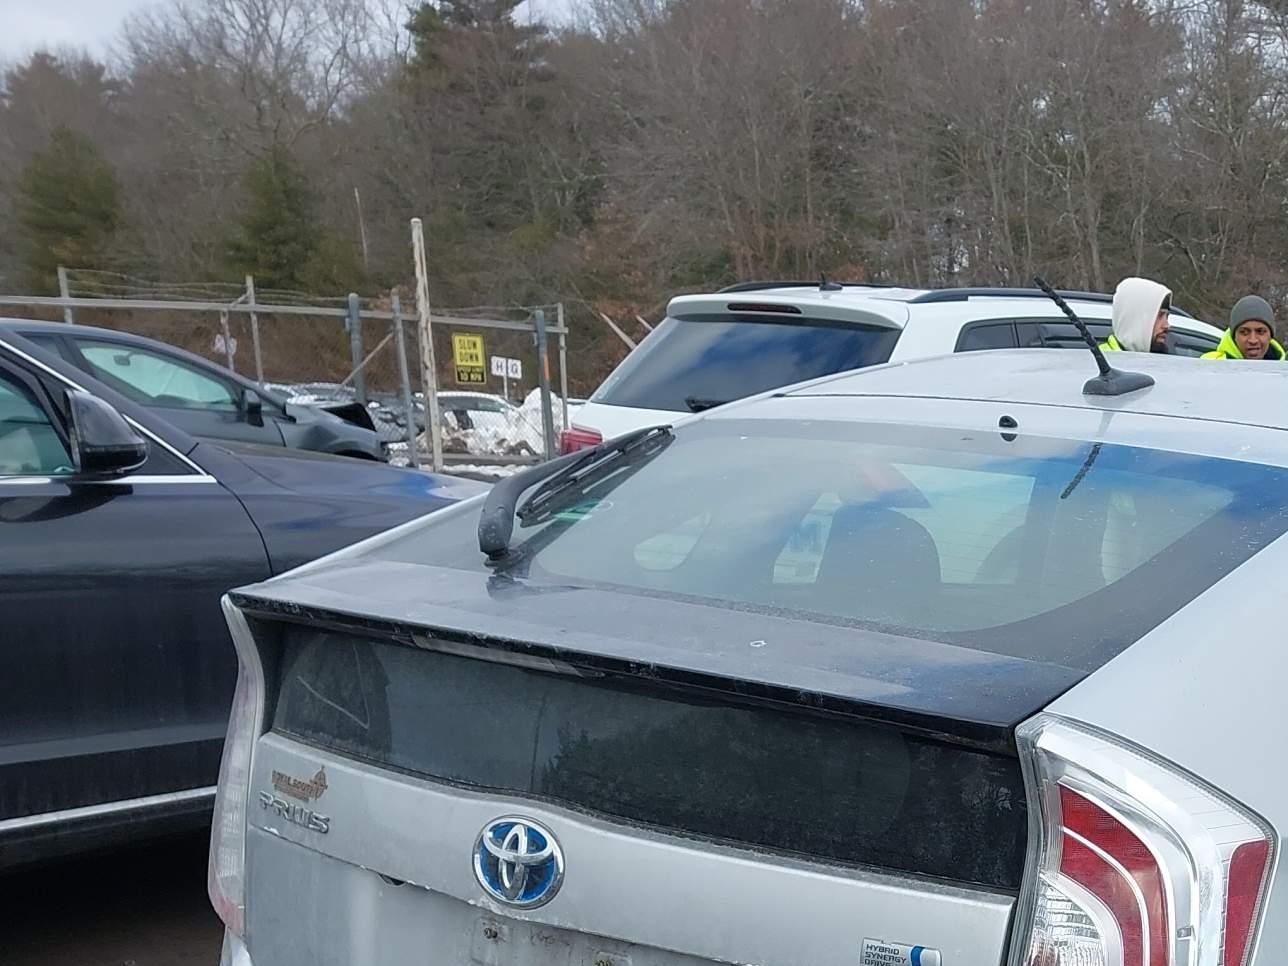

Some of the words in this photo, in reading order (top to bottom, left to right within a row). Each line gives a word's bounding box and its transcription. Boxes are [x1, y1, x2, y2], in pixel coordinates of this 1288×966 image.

[459, 338, 478, 350] SLOW
[460, 351, 480, 362] DOWN
[496, 361, 503, 372] H
[259, 791, 330, 833] PRIUS
[866, 943, 900, 955] HYBRID
[865, 951, 906, 964] SYNERGY
